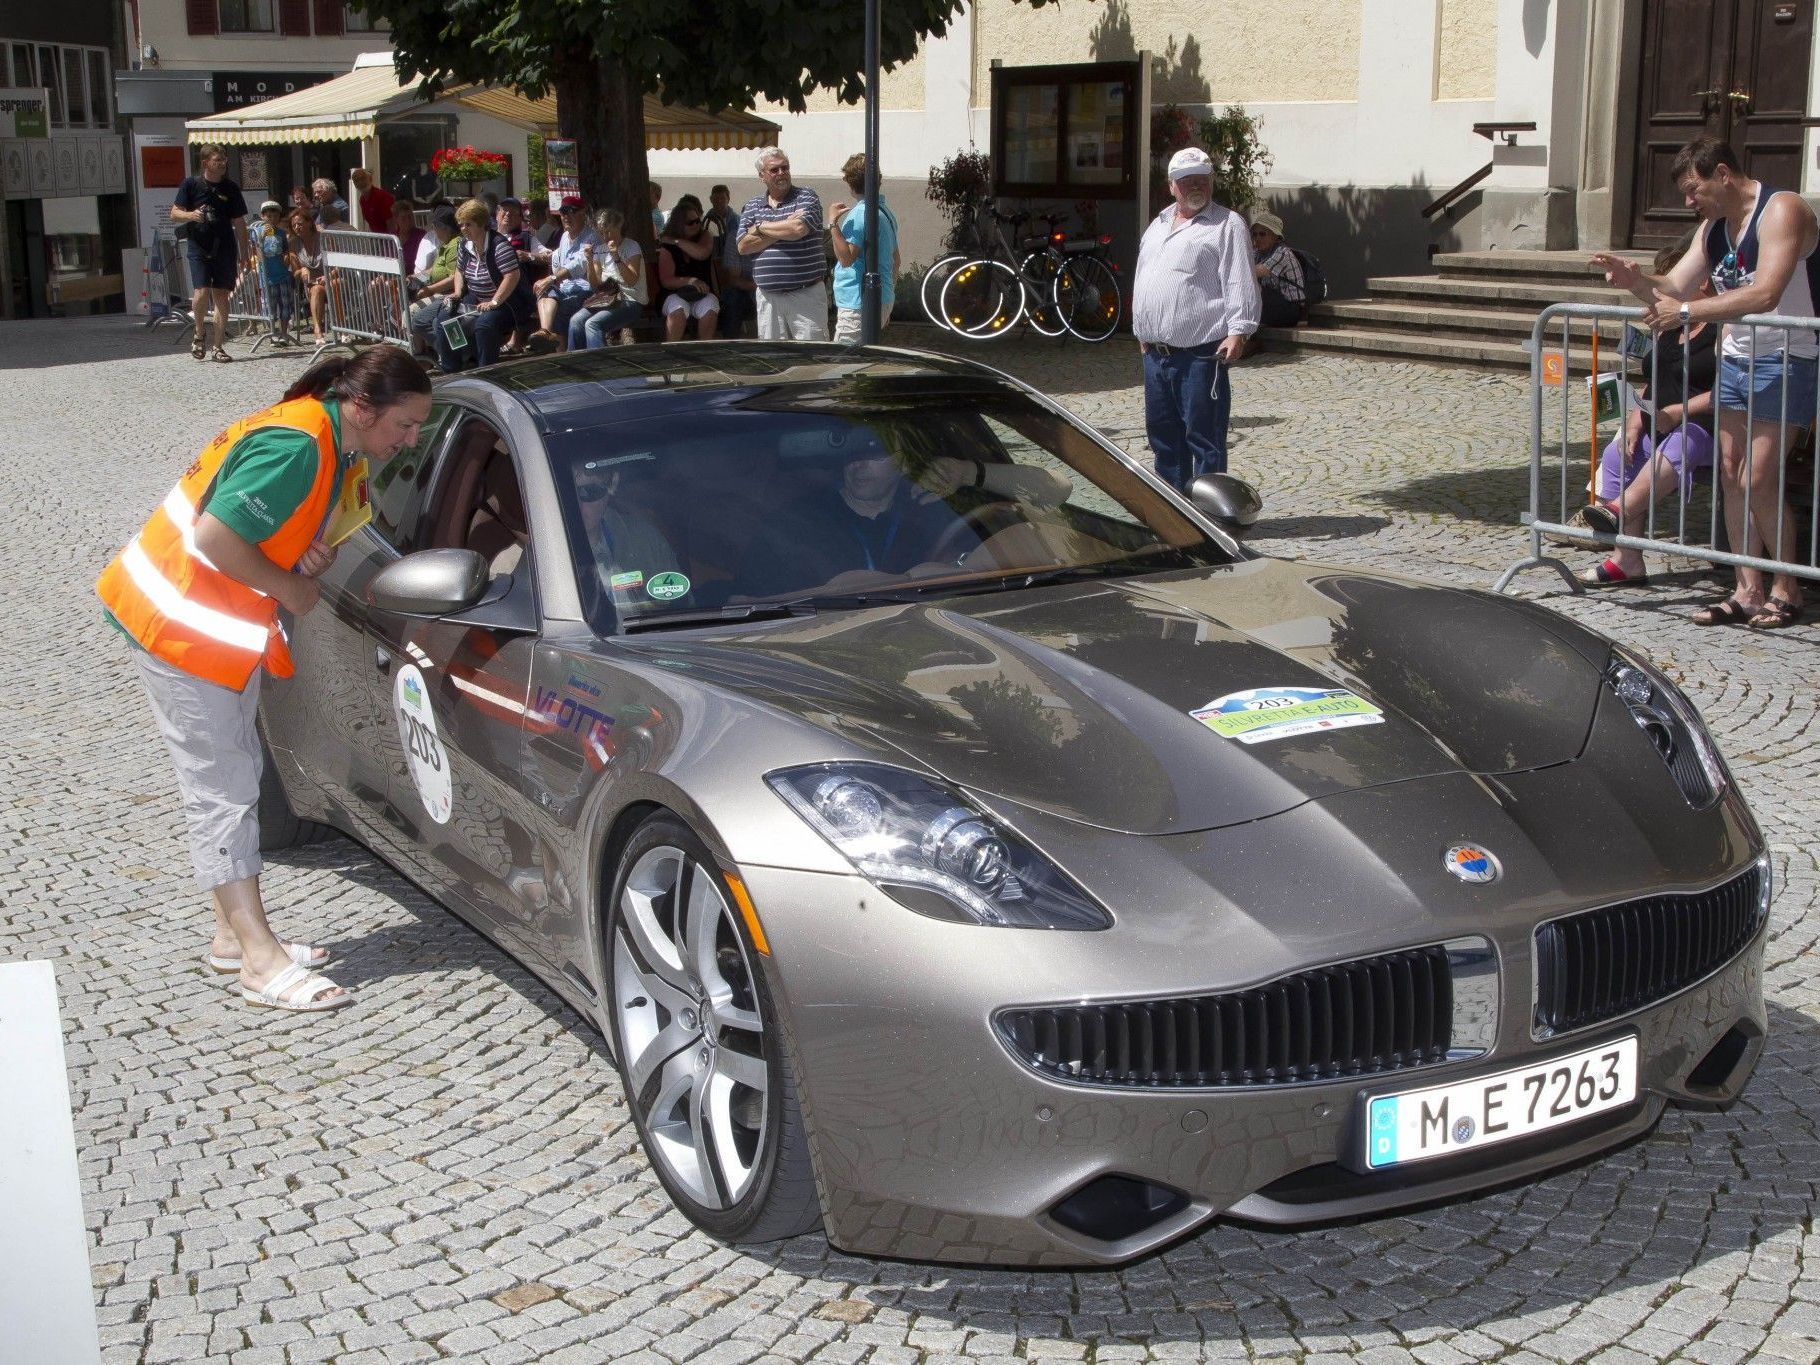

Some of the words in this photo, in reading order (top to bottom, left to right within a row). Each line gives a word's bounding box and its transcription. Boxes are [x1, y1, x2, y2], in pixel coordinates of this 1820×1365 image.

[227, 82, 321, 93] MOD
[227, 95, 243, 103] AM
[663, 574, 675, 586] 4
[1251, 697, 1293, 711] 203
[1219, 708, 1301, 729] SILVRETTA
[1303, 699, 1360, 715] E-AUTO
[401, 708, 441, 772] 203
[1420, 1096, 1449, 1148] M
[1483, 1082, 1508, 1135] E
[1523, 1051, 1620, 1124] 7263
